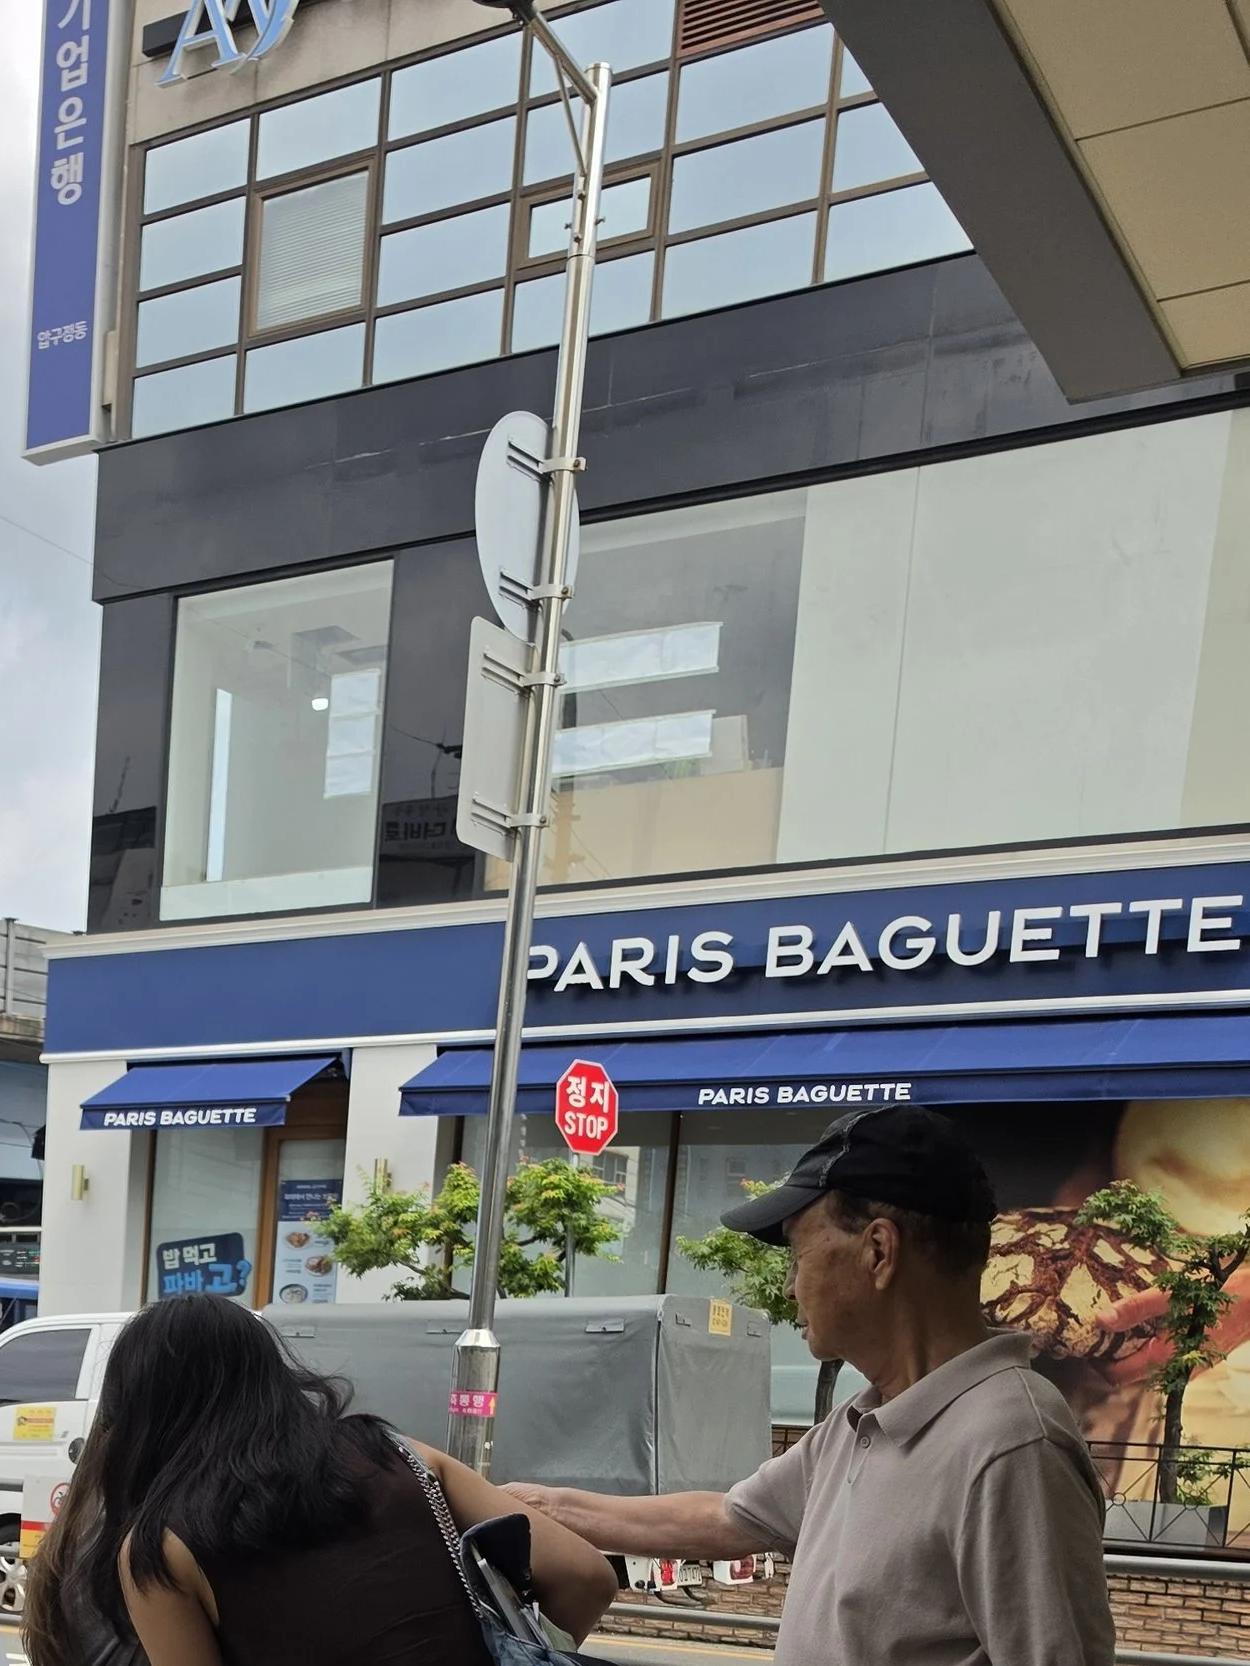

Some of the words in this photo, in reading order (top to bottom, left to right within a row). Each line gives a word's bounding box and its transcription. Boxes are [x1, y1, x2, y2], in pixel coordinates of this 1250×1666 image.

[37, 320, 88, 350] 압구정동
[526, 930, 734, 992] PARIS
[765, 895, 1243, 978] BAGUETTE
[566, 1076, 610, 1113] 정지
[698, 1087, 770, 1105] PARIS
[777, 1083, 912, 1103] BAGUETTE
[103, 1111, 156, 1126] PARIS
[160, 1108, 257, 1125] BAGUETTE
[564, 1111, 609, 1140] STOP
[162, 1248, 180, 1270] 밥
[182, 1243, 217, 1265] 먹고
